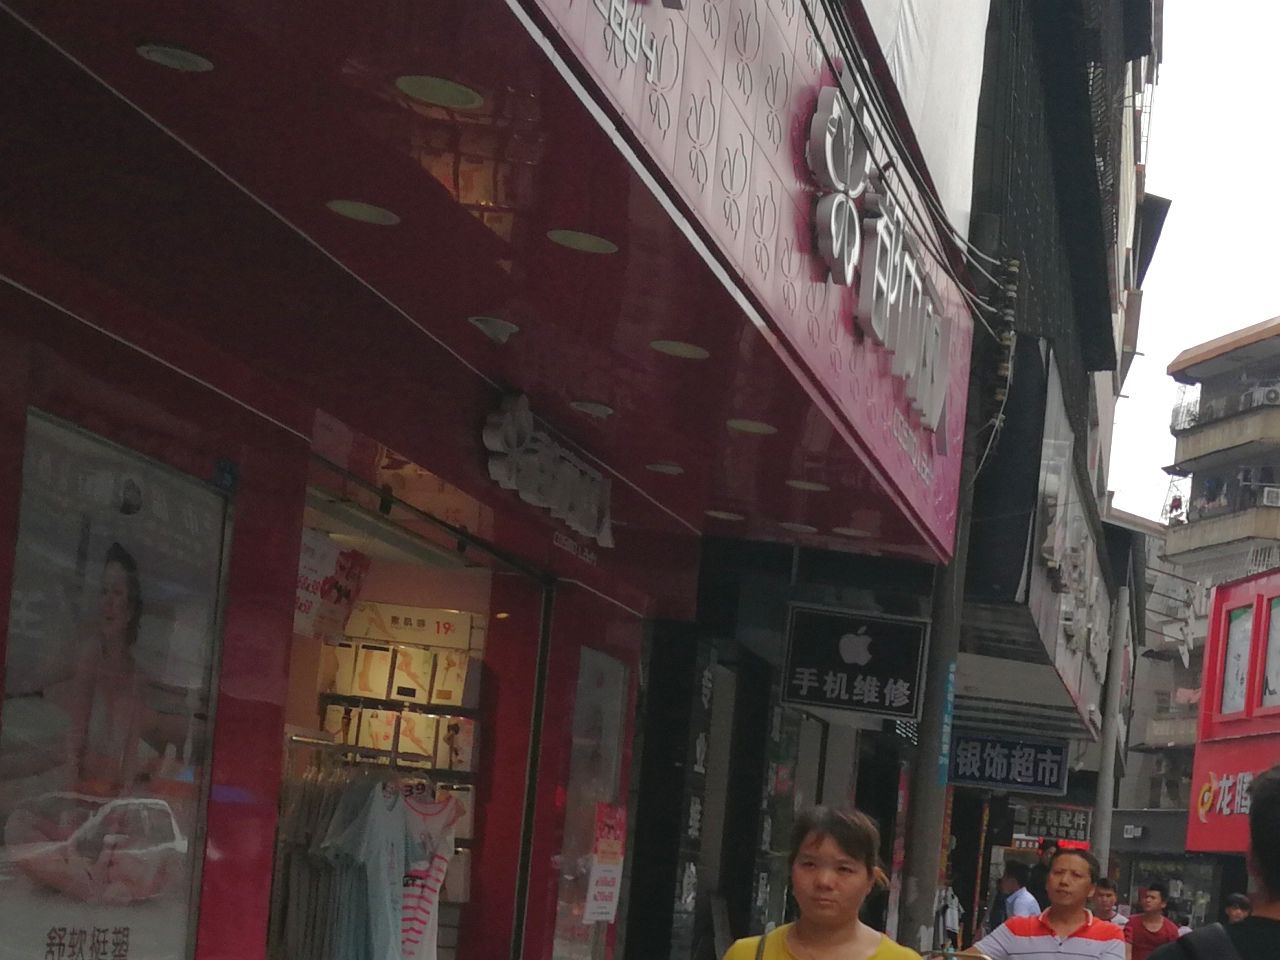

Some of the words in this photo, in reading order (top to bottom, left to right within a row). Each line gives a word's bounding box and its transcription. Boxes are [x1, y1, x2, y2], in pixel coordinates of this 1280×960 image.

[792, 667, 911, 707] 手机维修
[956, 741, 1061, 786] 银饰超市
